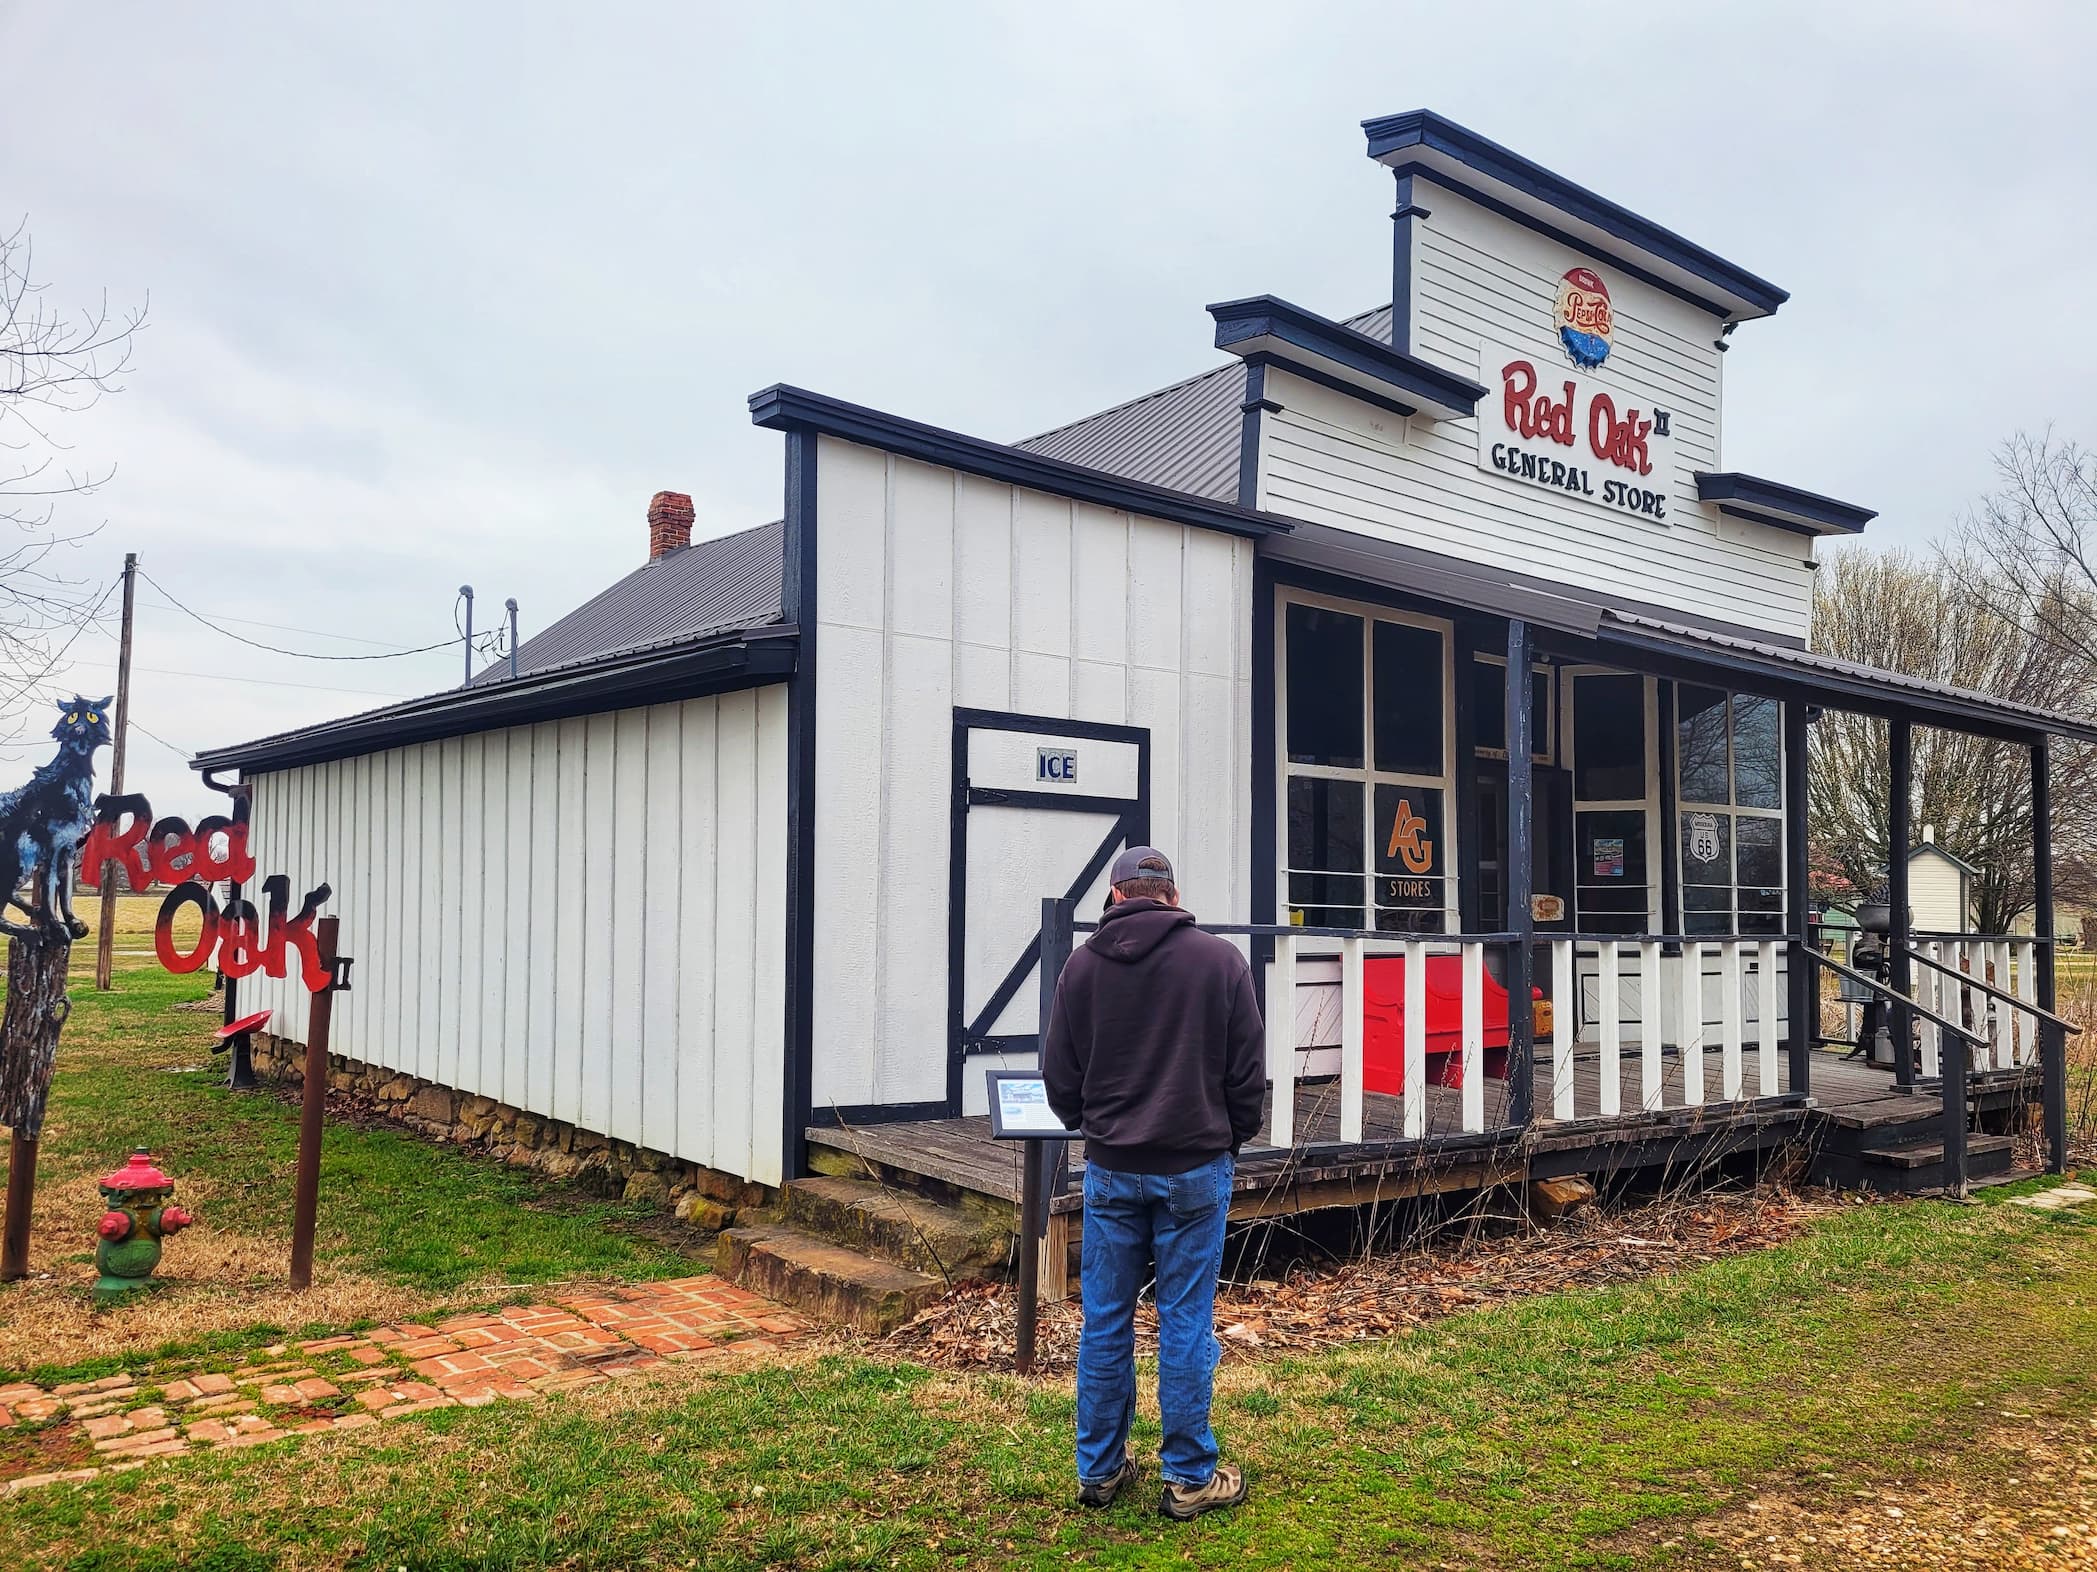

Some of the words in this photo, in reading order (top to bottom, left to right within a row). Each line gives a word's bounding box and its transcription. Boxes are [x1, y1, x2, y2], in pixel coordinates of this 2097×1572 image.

[1502, 360, 1576, 446] Red
[1589, 393, 1652, 476] Oak
[1491, 443, 1594, 495] GENERAL
[1602, 480, 1666, 518] STORE
[1039, 752, 1074, 779] ICE
[81, 784, 256, 893] Red
[1387, 799, 1433, 874] AG
[1698, 838, 1712, 855] 66
[1390, 880, 1431, 897] STORES
[155, 874, 332, 992] Oak
